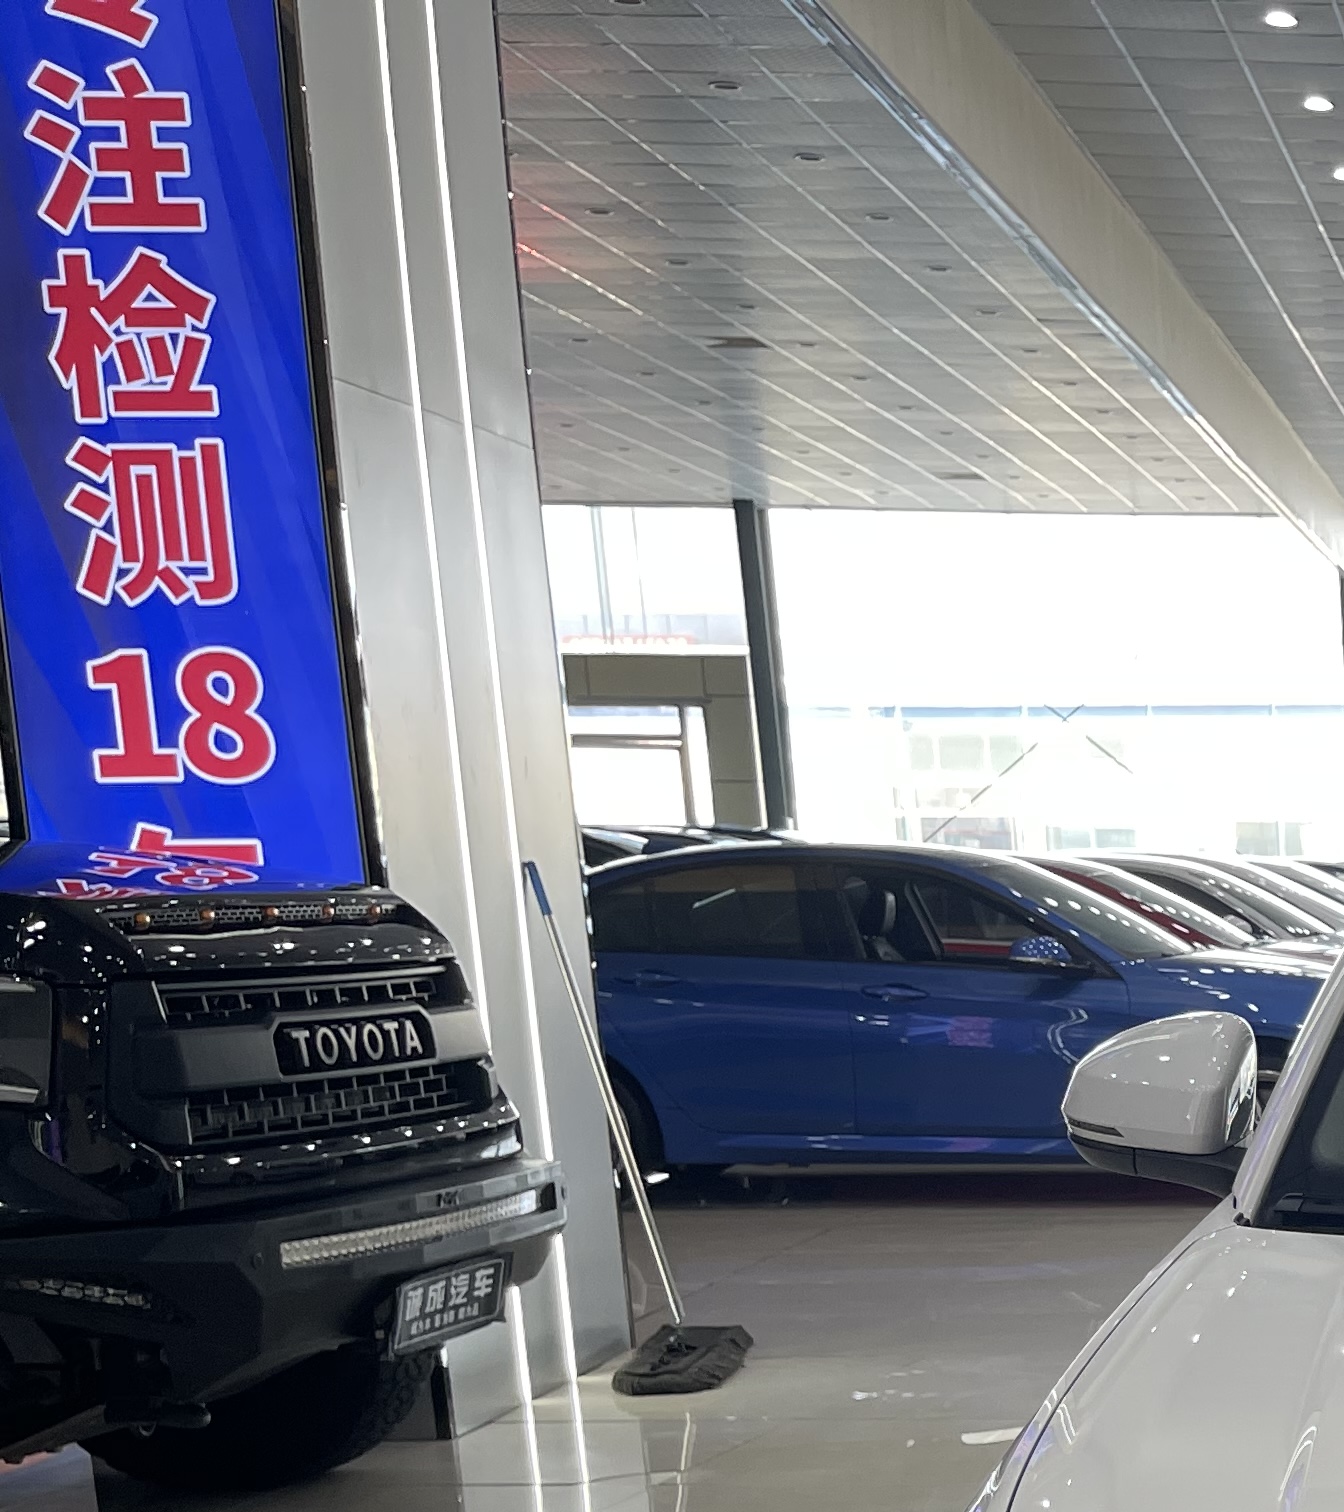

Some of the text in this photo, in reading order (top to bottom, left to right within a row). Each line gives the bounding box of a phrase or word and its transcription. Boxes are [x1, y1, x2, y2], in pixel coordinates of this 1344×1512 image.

[25, 0, 276, 866] 注检测18
[290, 1019, 424, 1068] TOYOTA
